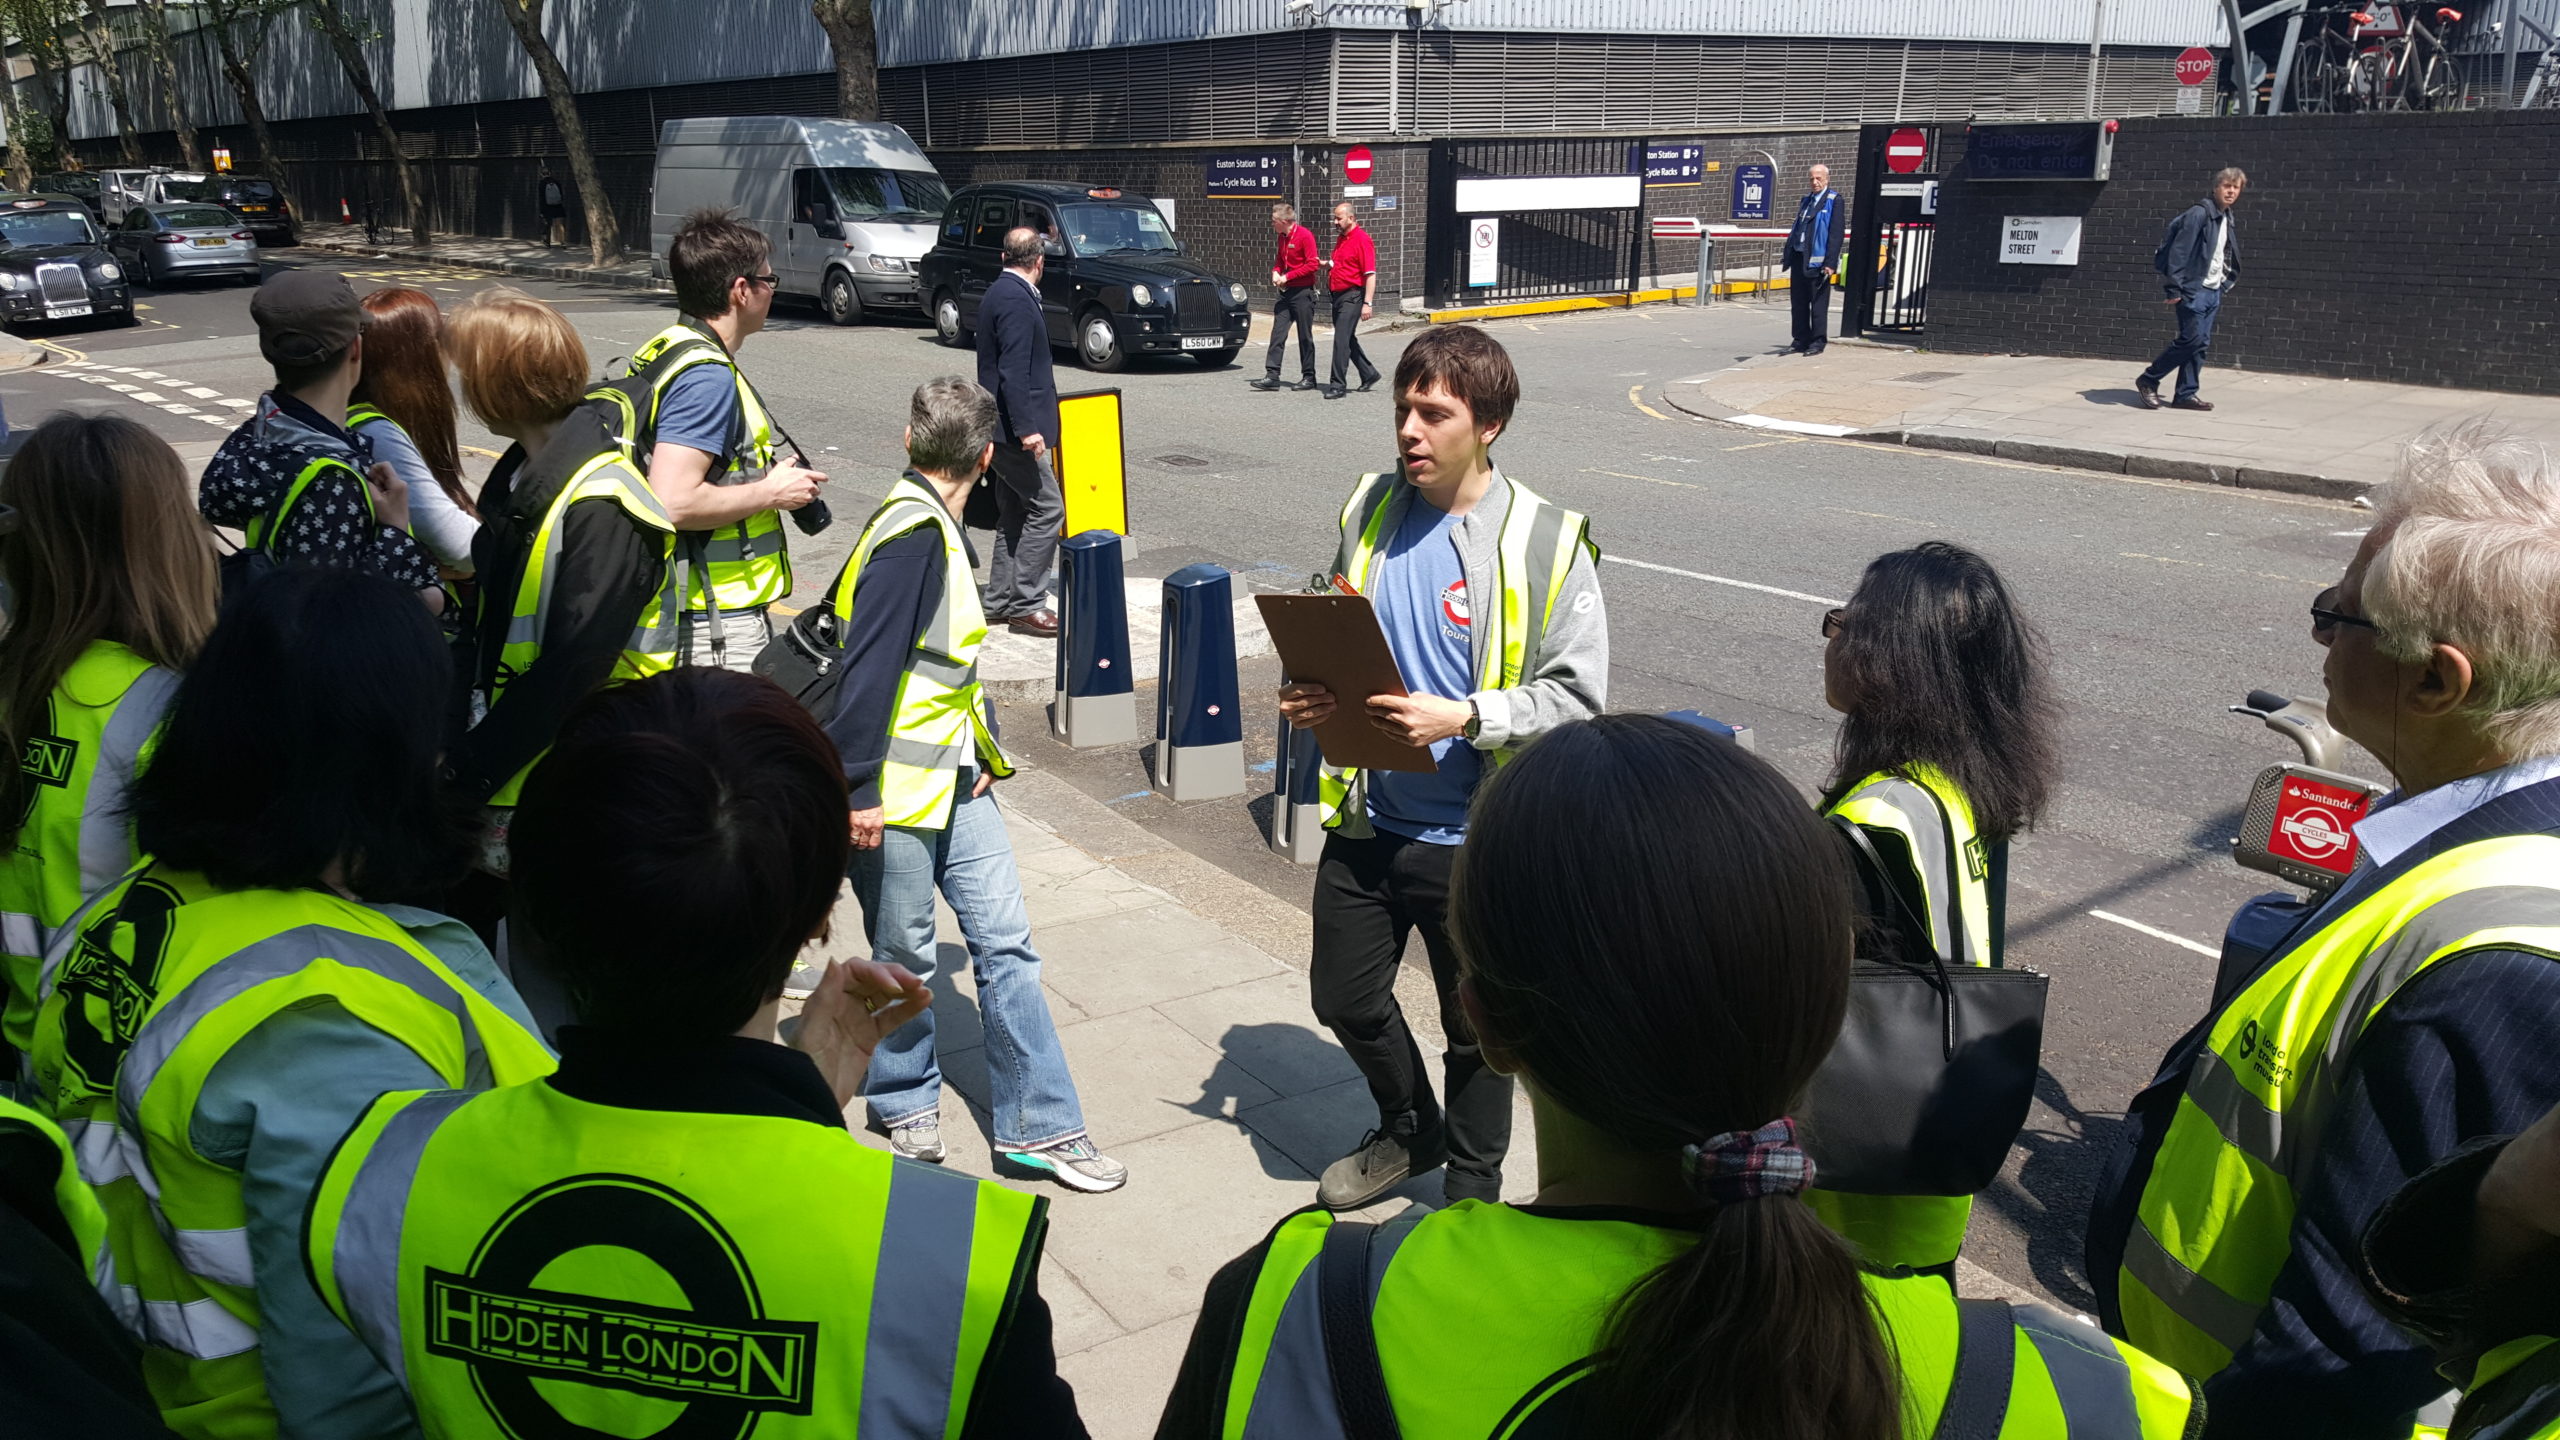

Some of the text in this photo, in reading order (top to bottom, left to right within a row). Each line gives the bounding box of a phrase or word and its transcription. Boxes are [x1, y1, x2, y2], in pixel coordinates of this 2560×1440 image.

[2177, 60, 2211, 73] STOP
[1979, 132, 2073, 150] Emergency
[1658, 150, 1679, 159] Station
[1216, 158, 1257, 168] Euston Station
[1978, 154, 2086, 169] Do not enter
[1223, 177, 1240, 188] Cycle
[1240, 177, 1257, 187] Racks
[2010, 230, 2038, 241] MELTON
[2008, 244, 2036, 254] STREET
[1185, 338, 1206, 348] LS60
[1442, 625, 1470, 643] Tours
[2301, 788, 2359, 812] Santander
[2301, 827, 2328, 839] CYCLES
[440, 1287, 795, 1397] HIDDEN LONDON
